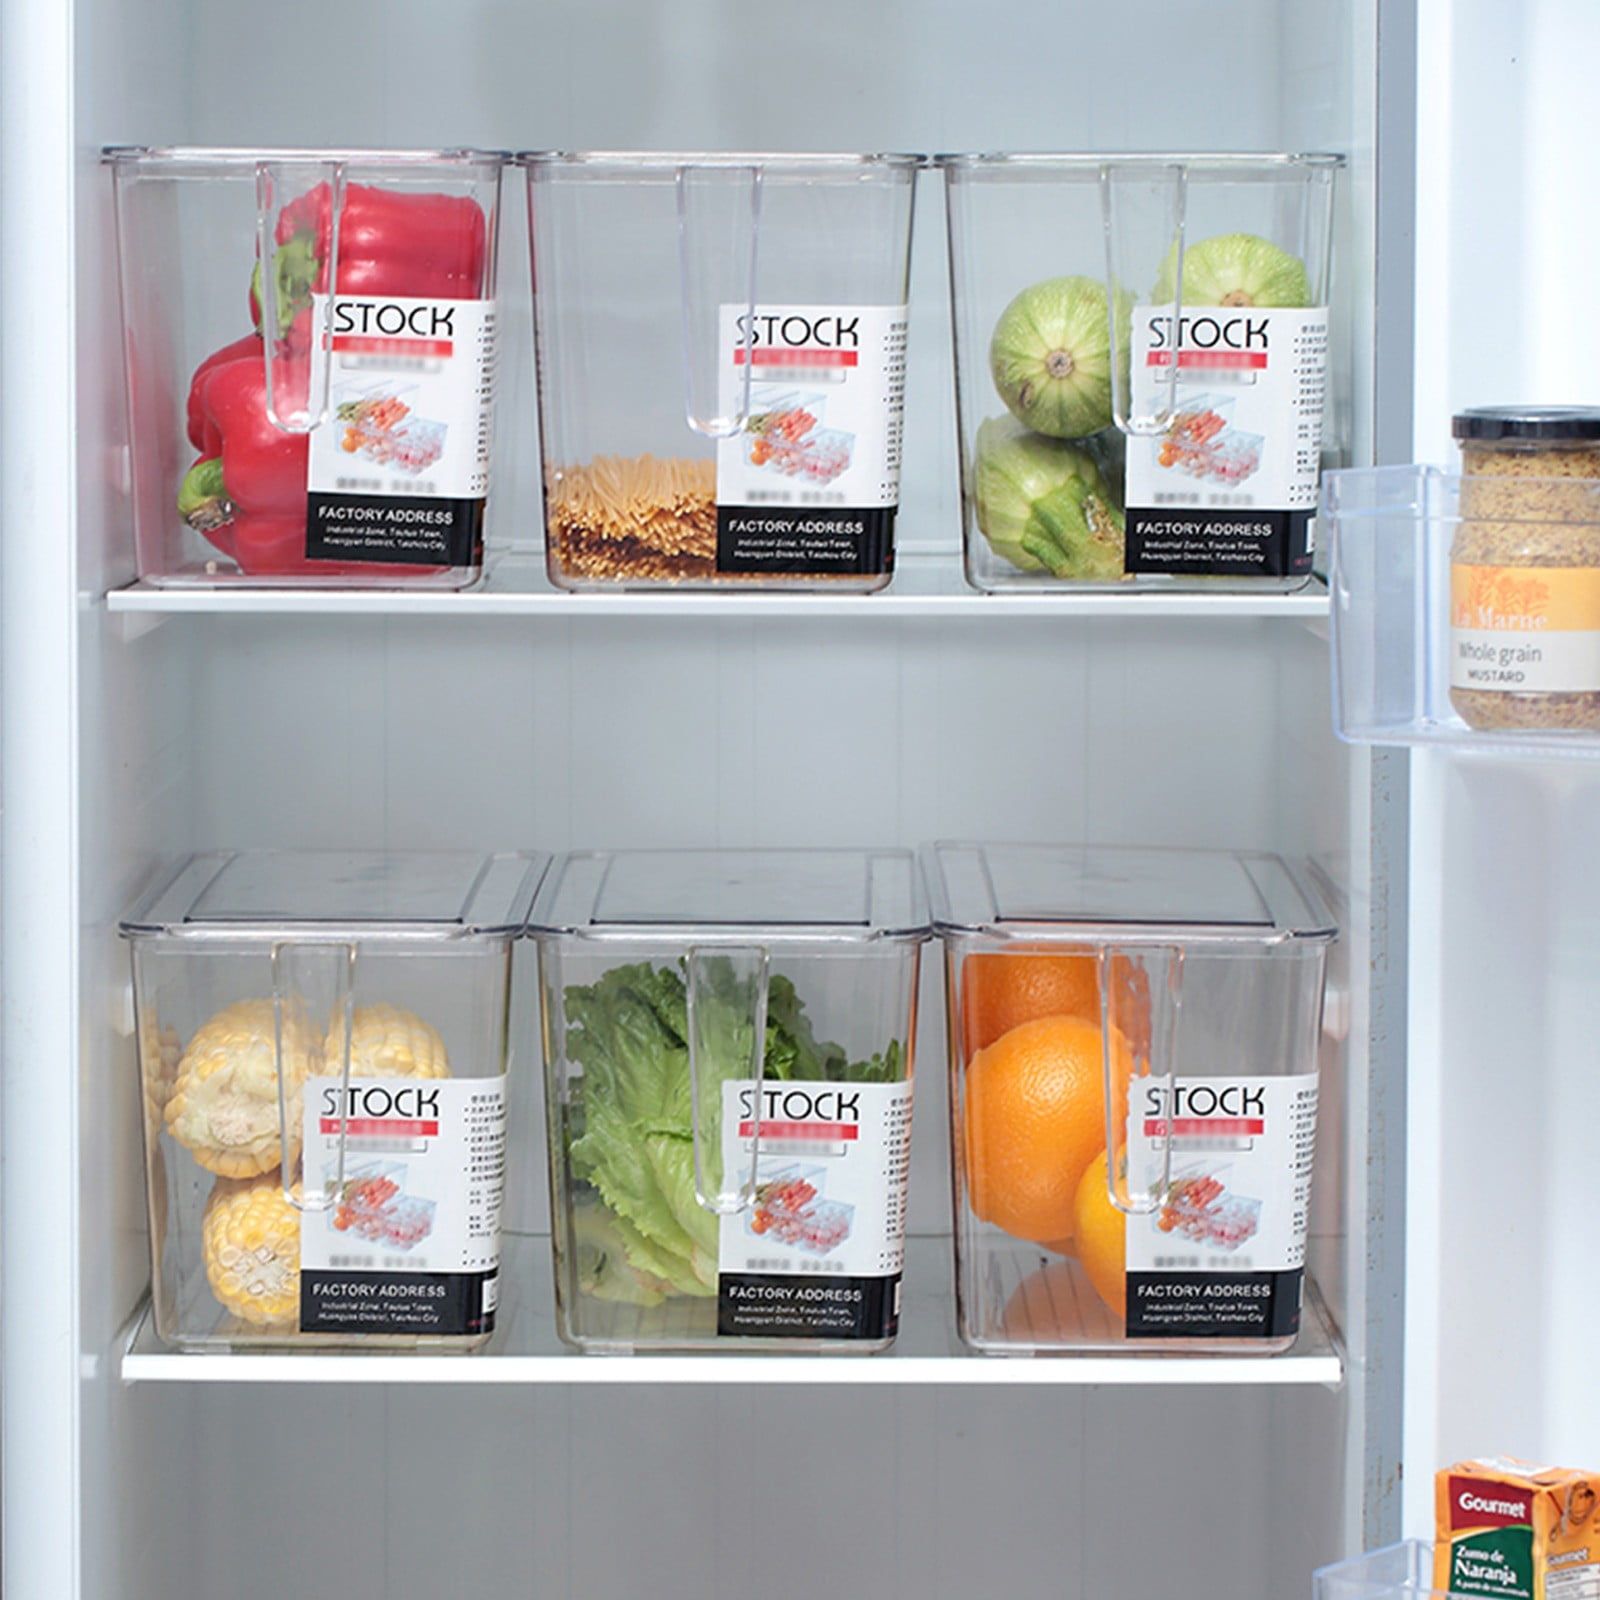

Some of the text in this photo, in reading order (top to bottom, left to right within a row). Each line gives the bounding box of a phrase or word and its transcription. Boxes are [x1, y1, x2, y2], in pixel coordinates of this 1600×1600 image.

[333, 302, 455, 336] STOCK
[736, 315, 859, 346] STOCK
[1149, 317, 1270, 348] STOCK
[319, 506, 453, 525] FACTORY ADDRESS
[728, 520, 864, 534] FACTORY ADDRESS
[1136, 522, 1272, 537] FACTORY ADDRESS
[1477, 605, 1548, 630] Marne
[1498, 643, 1543, 667] grain
[1467, 669, 1526, 682] MUSTARD
[322, 1087, 440, 1117] STOCK
[739, 1090, 861, 1121] STOCK
[1145, 1086, 1266, 1116] STOCK
[312, 1283, 447, 1298] FACTORY ADDRESS
[729, 1287, 862, 1302] FACTORY ADDRESS
[1137, 1284, 1271, 1298] FACTORY ADDRESS
[1458, 1491, 1526, 1519] Gourmet
[1456, 1544, 1505, 1563] Zumo de
[1455, 1558, 1517, 1586] Naranja
